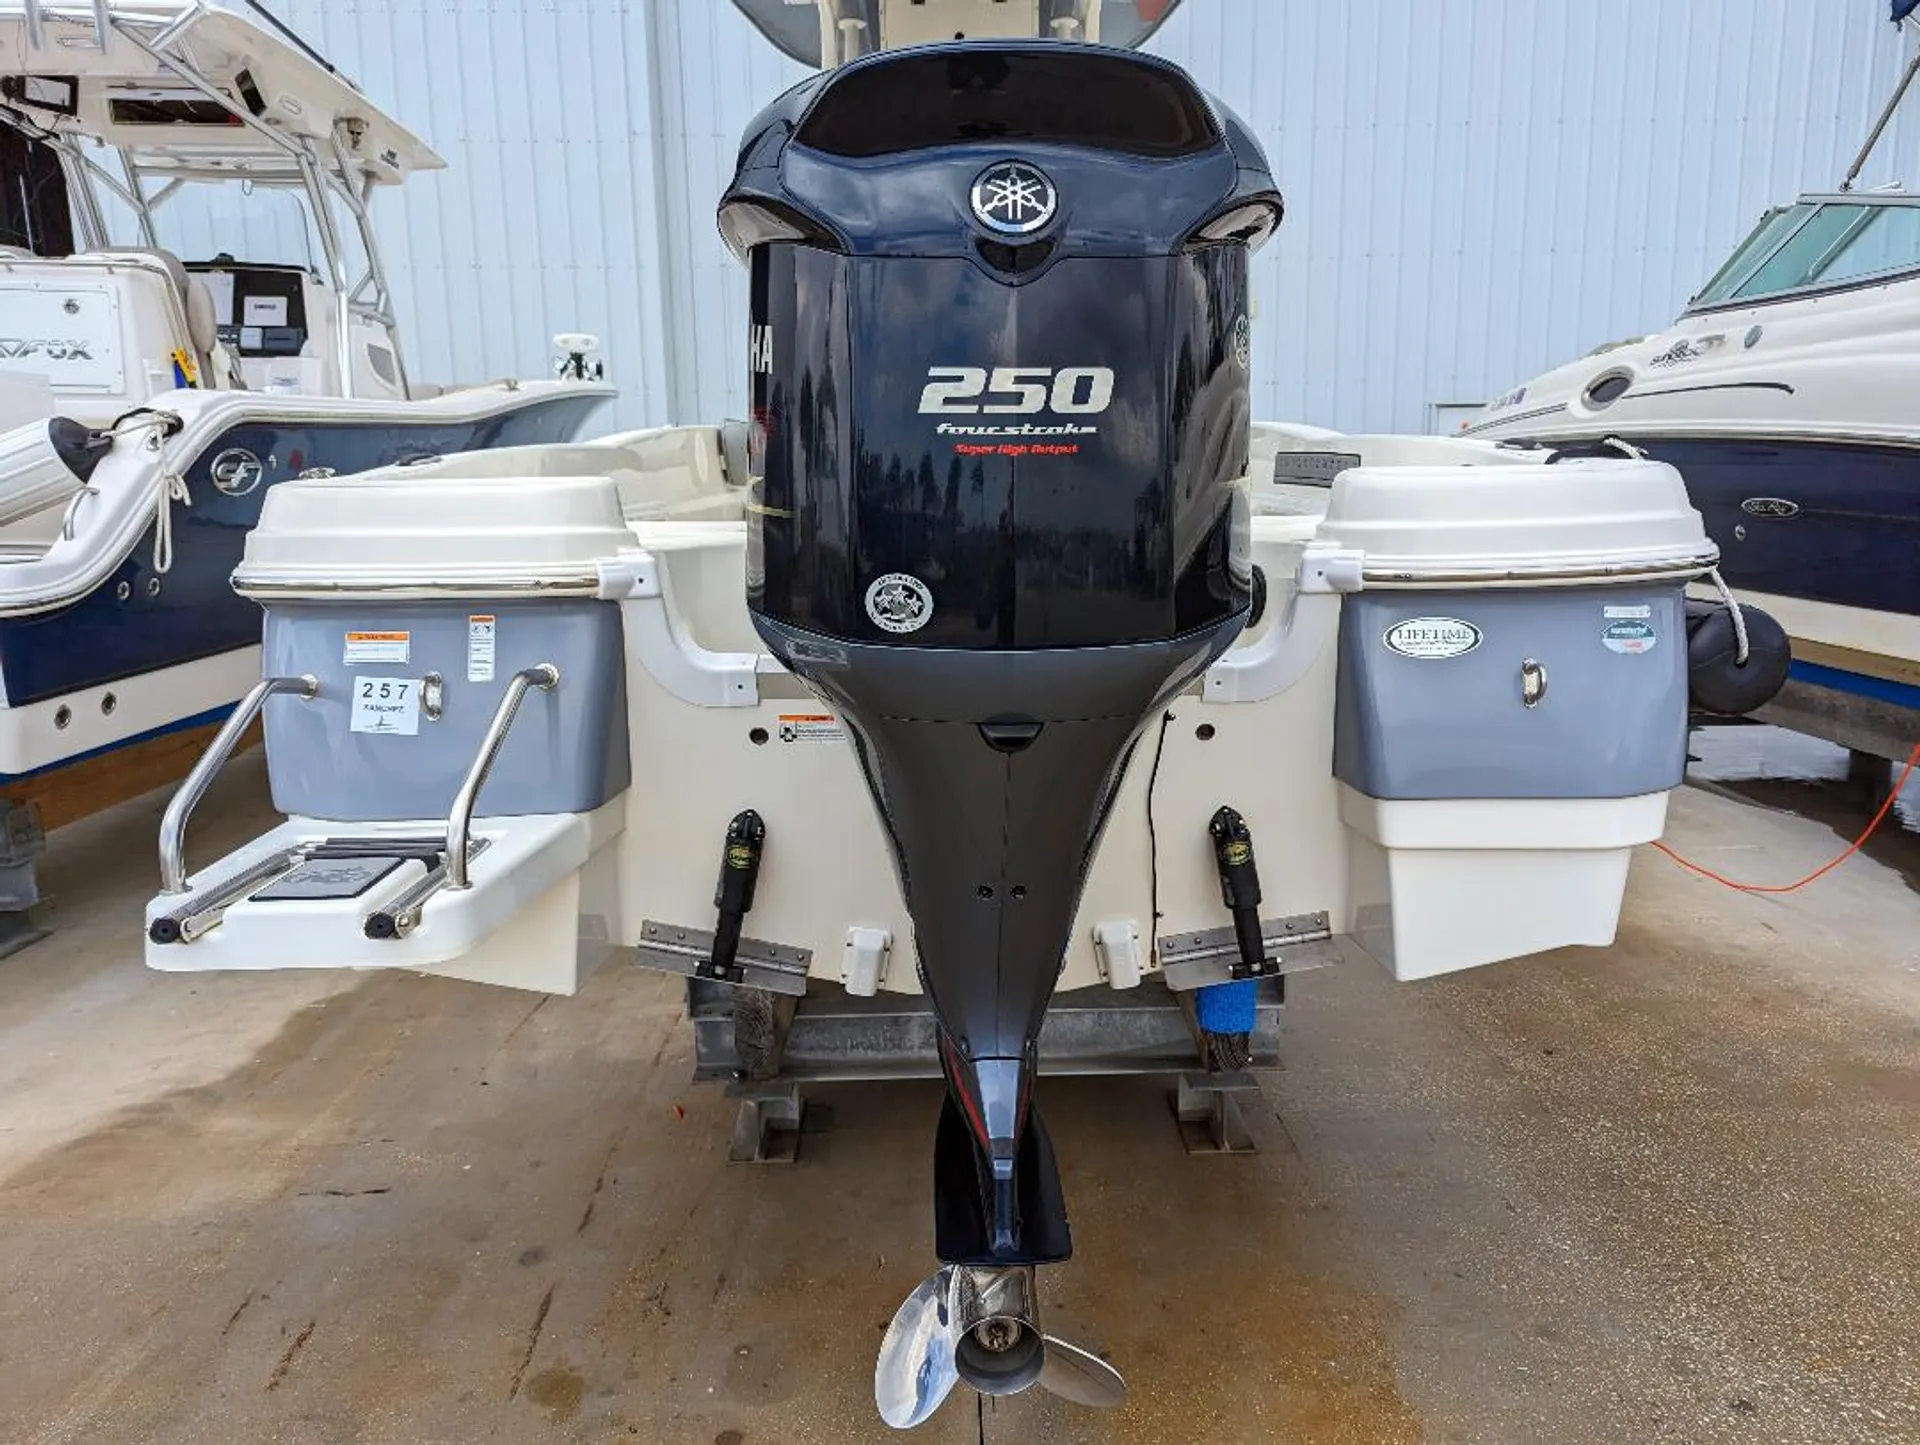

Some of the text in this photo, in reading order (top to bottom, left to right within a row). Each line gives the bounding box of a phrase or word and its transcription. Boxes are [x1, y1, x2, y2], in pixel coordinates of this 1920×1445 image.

[918, 367, 1114, 413] 250
[955, 444, 1079, 457] Super High Output
[1398, 629, 1471, 640] LIFETIME
[362, 682, 409, 700] 257
